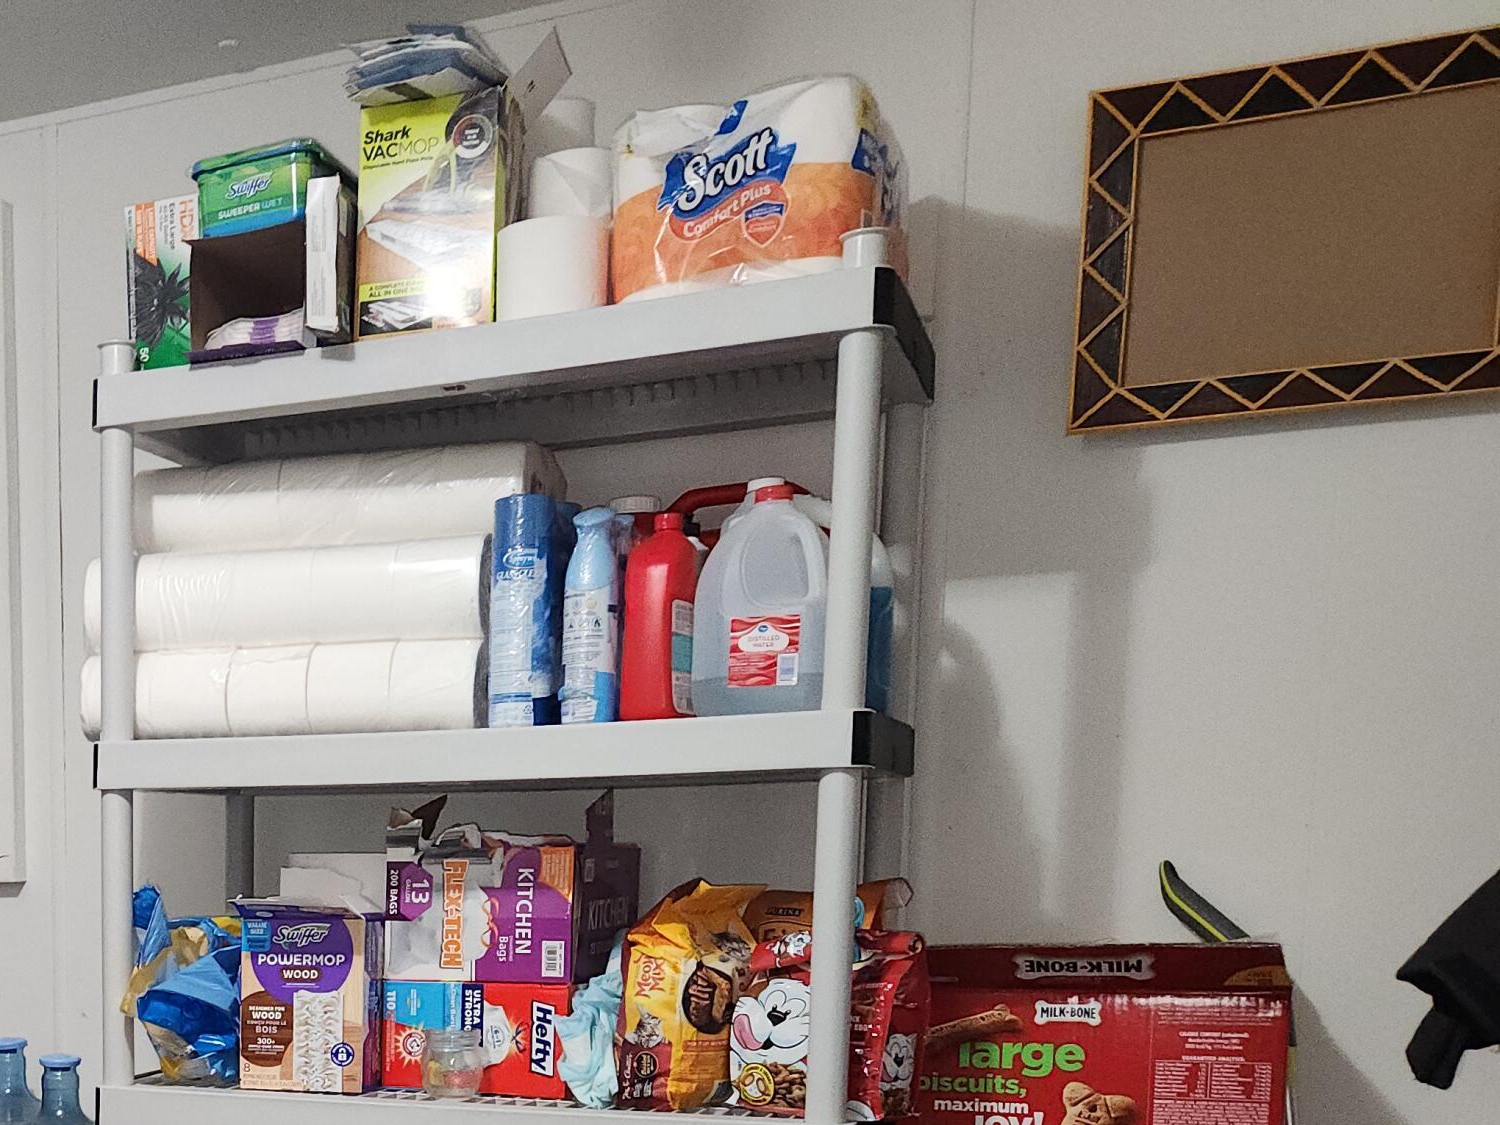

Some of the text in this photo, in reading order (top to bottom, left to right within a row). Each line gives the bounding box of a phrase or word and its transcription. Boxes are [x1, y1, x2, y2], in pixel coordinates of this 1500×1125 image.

[364, 126, 411, 144] Shark
[363, 137, 439, 161] VACMOP
[677, 127, 774, 211] Scott
[226, 173, 273, 197] Swiffer
[218, 202, 260, 219] SWEEPER
[683, 197, 739, 238] Comfort
[740, 184, 771, 207] Plus
[389, 869, 399, 915] 200 BAGS
[411, 878, 430, 904] 13
[441, 860, 469, 968] FLEX-TECH
[515, 868, 535, 954] KITCHEN
[273, 922, 332, 947] Swiffer
[257, 953, 346, 967] POWERMOP
[499, 936, 509, 962] Bags
[282, 969, 319, 979] WOOD
[1024, 958, 1143, 974] MILK-BONE
[252, 1011, 282, 1019] WOOD
[473, 989, 482, 1024] ULTRA
[1039, 1005, 1097, 1019] MILK-BONE
[255, 1025, 278, 1033] BOIS
[531, 1006, 553, 1072] Hefty
[958, 1041, 1086, 1077] large
[933, 1098, 1029, 1114] maximum
